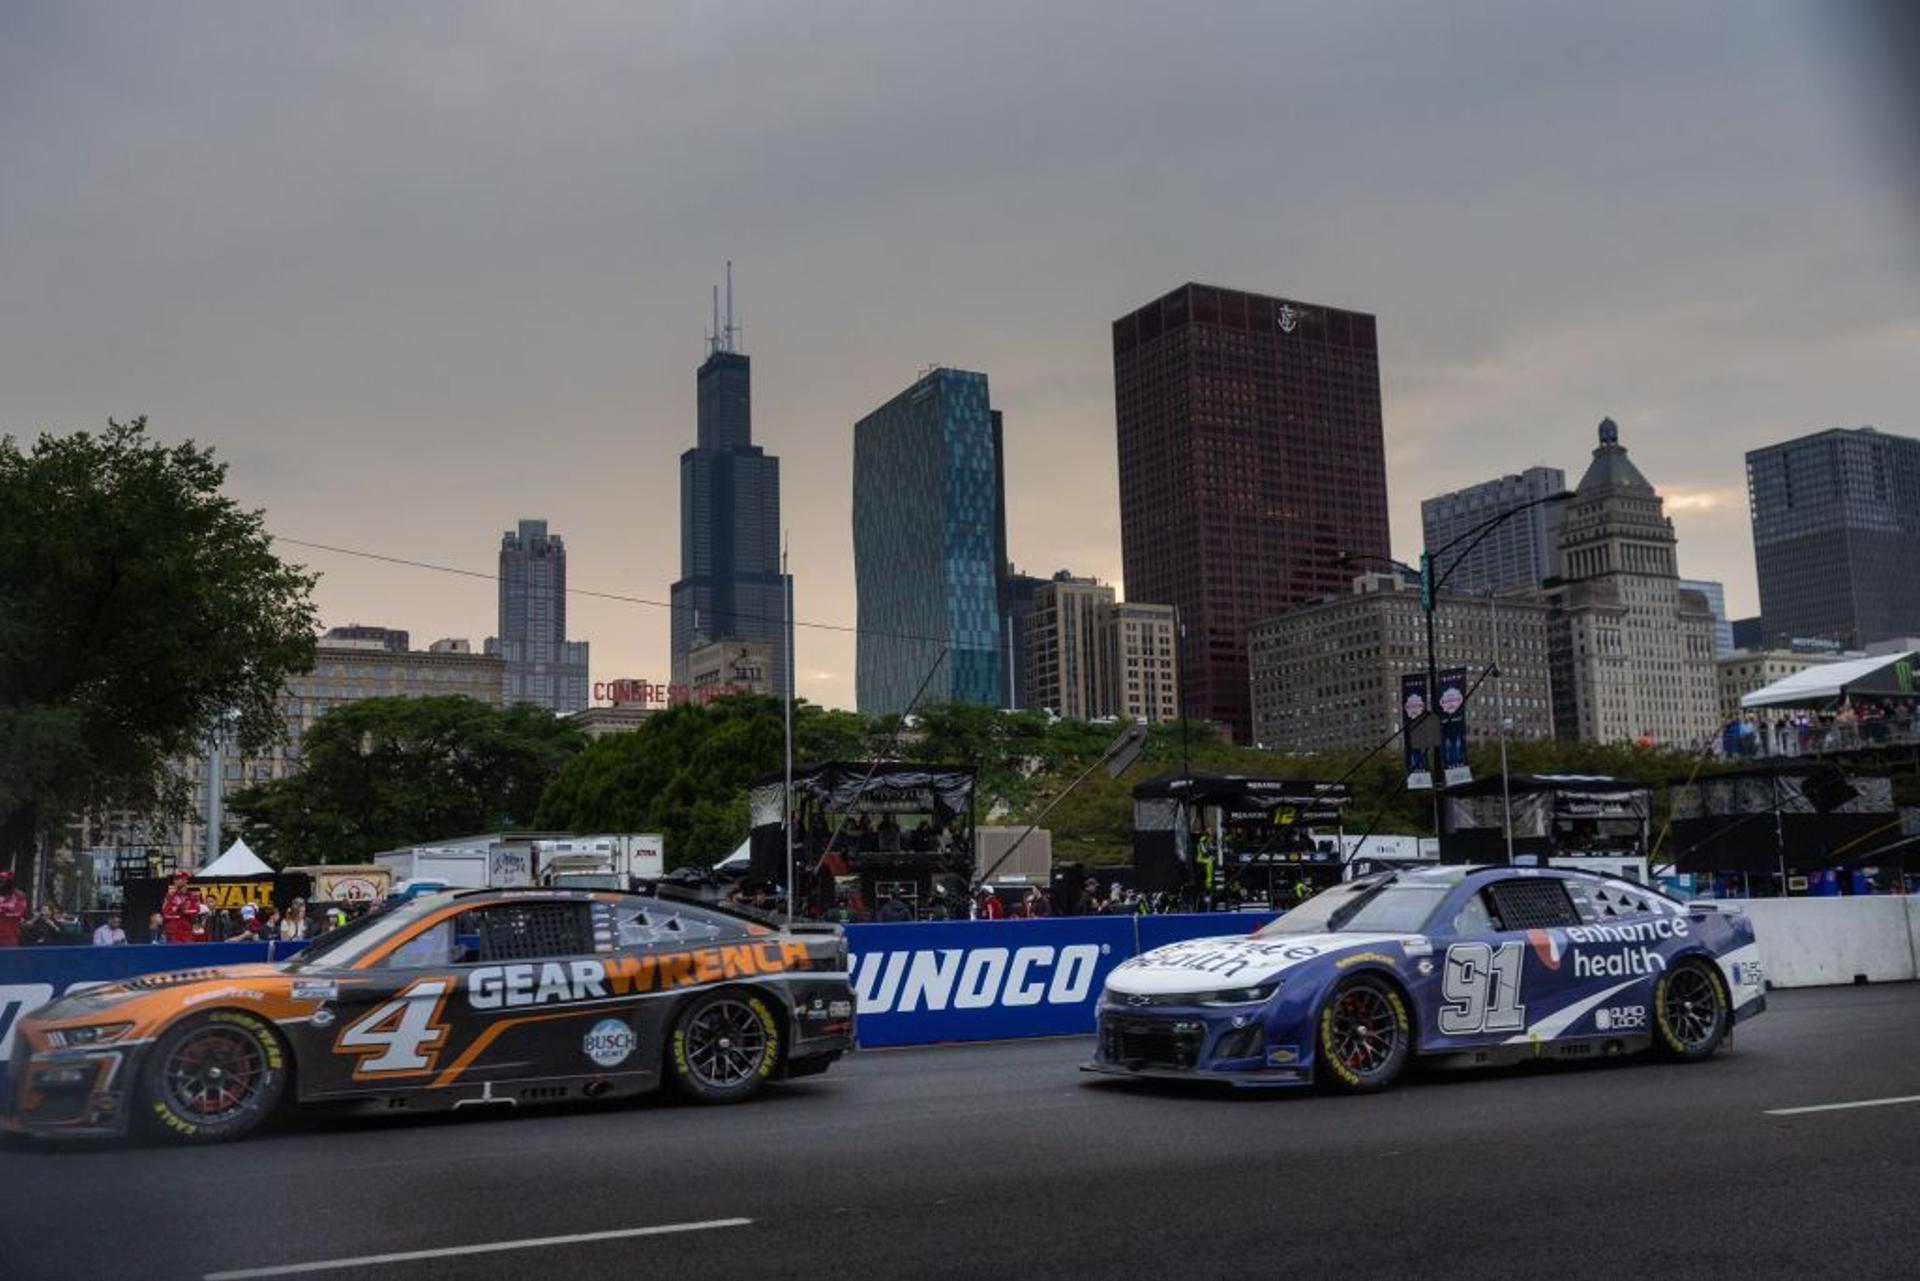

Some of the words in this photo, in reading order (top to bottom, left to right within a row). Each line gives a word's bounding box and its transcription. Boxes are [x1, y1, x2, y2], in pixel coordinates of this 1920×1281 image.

[593, 682, 688, 704] CONGRESS
[194, 881, 274, 908] WALT
[1567, 916, 1689, 944] enhance
[467, 942, 812, 1010] GEARWRENCH
[1574, 946, 1666, 978] health
[848, 944, 1100, 1014] UNOCO
[1438, 941, 1526, 1035] 91
[335, 976, 457, 1080] 4
[585, 1033, 634, 1052] BUSCH
